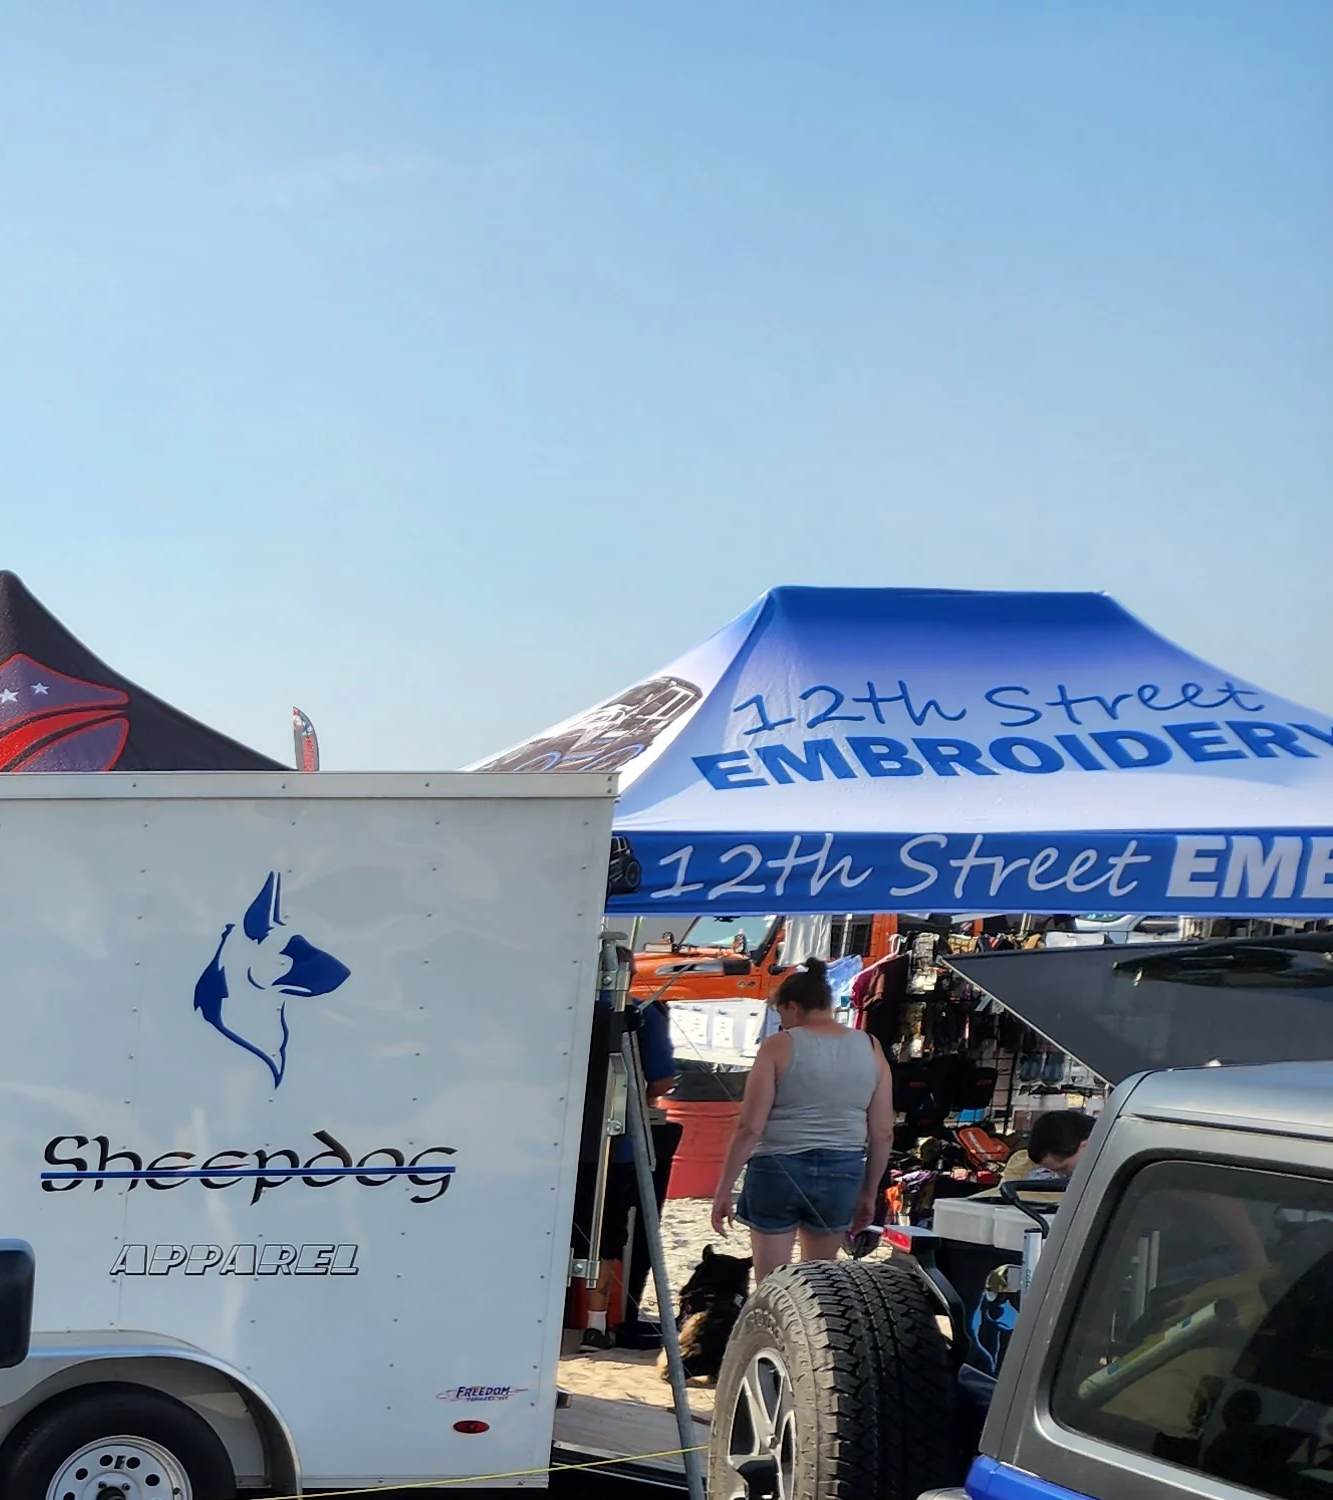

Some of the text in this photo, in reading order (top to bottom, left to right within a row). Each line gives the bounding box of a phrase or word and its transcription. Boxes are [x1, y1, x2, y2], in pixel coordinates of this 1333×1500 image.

[734, 680, 1265, 735] 12th Street
[651, 832, 874, 900] 12th
[890, 832, 1152, 900] Street
[40, 1129, 458, 1206] Sheepdog
[109, 1243, 360, 1276] APPAREL
[456, 1386, 511, 1398] FREEDOM
